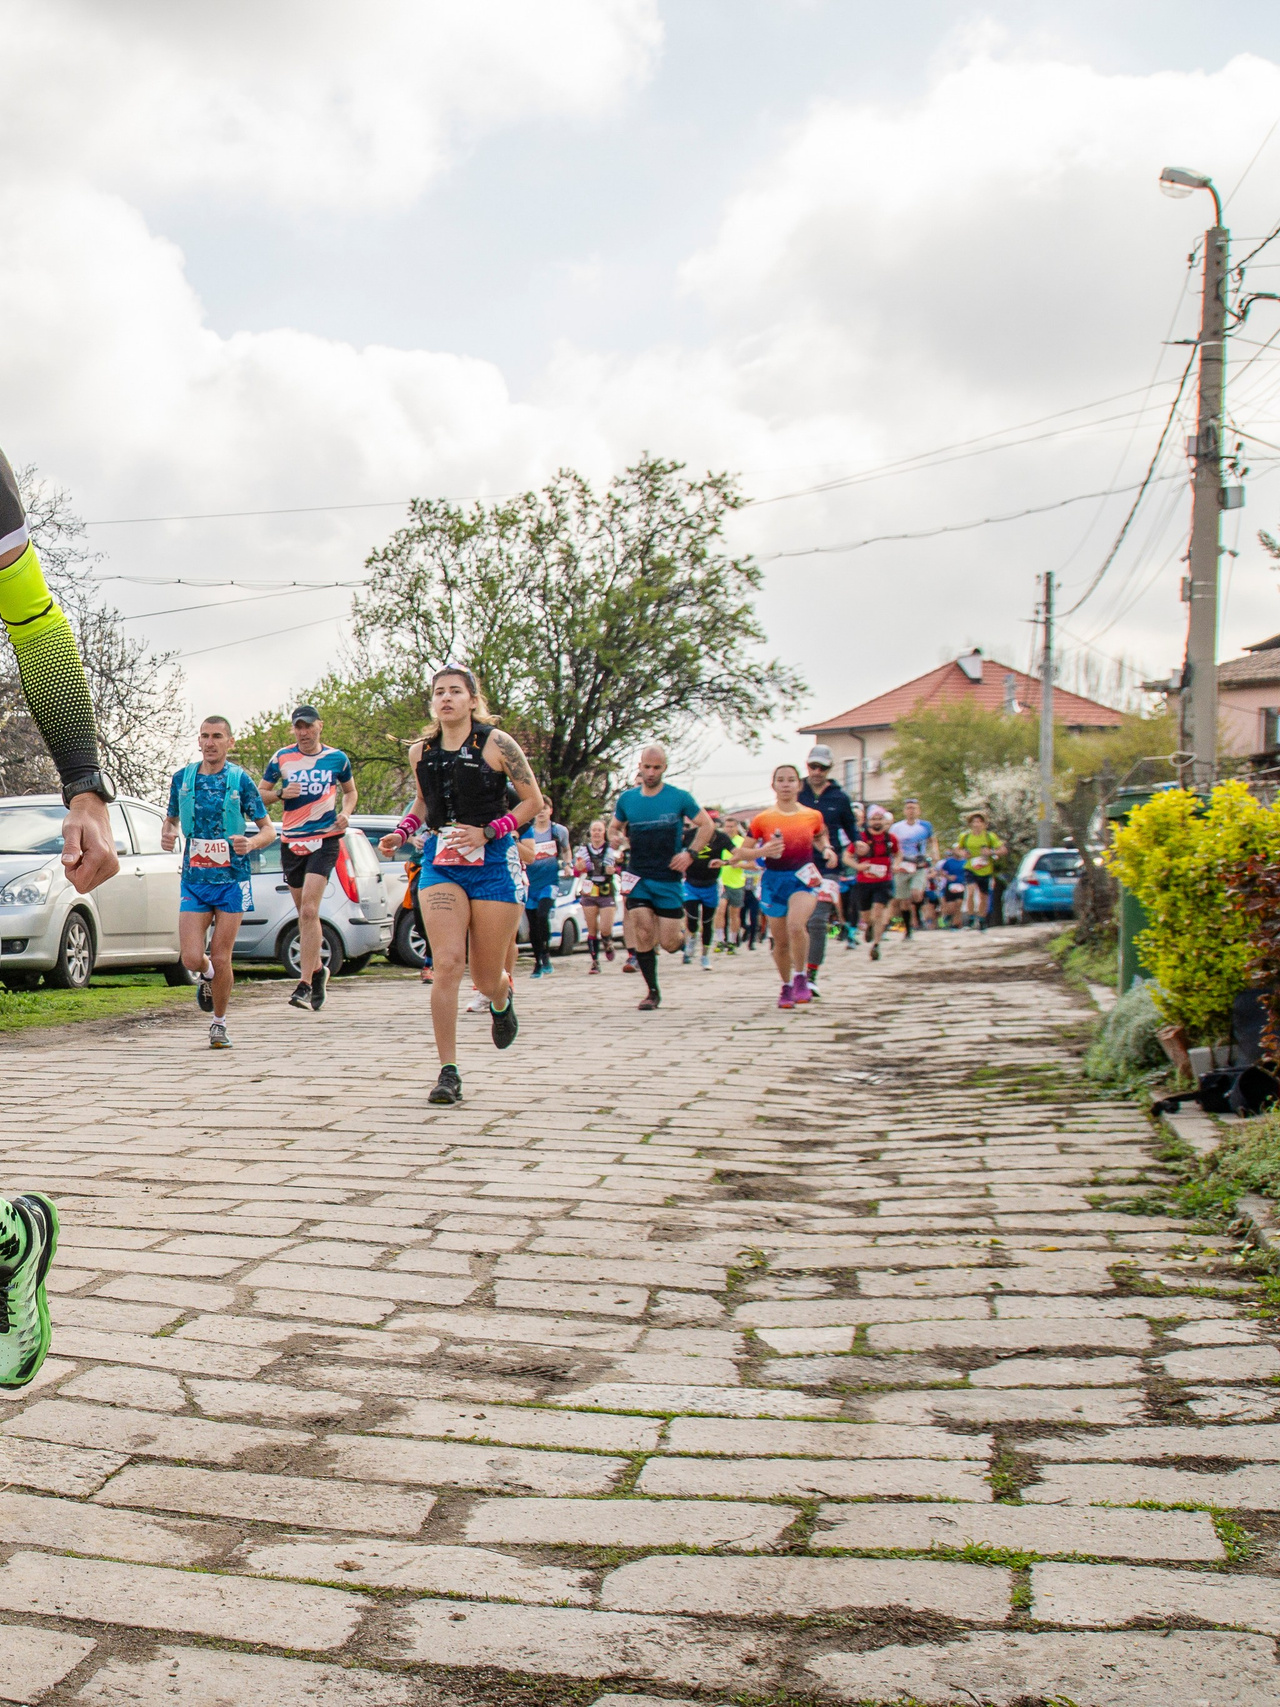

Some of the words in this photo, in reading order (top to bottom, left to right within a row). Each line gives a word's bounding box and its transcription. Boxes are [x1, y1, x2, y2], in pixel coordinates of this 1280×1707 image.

[288, 770, 332, 782] БАСИ
[301, 781, 330, 795] ЕФА
[204, 842, 227, 854] 2415
